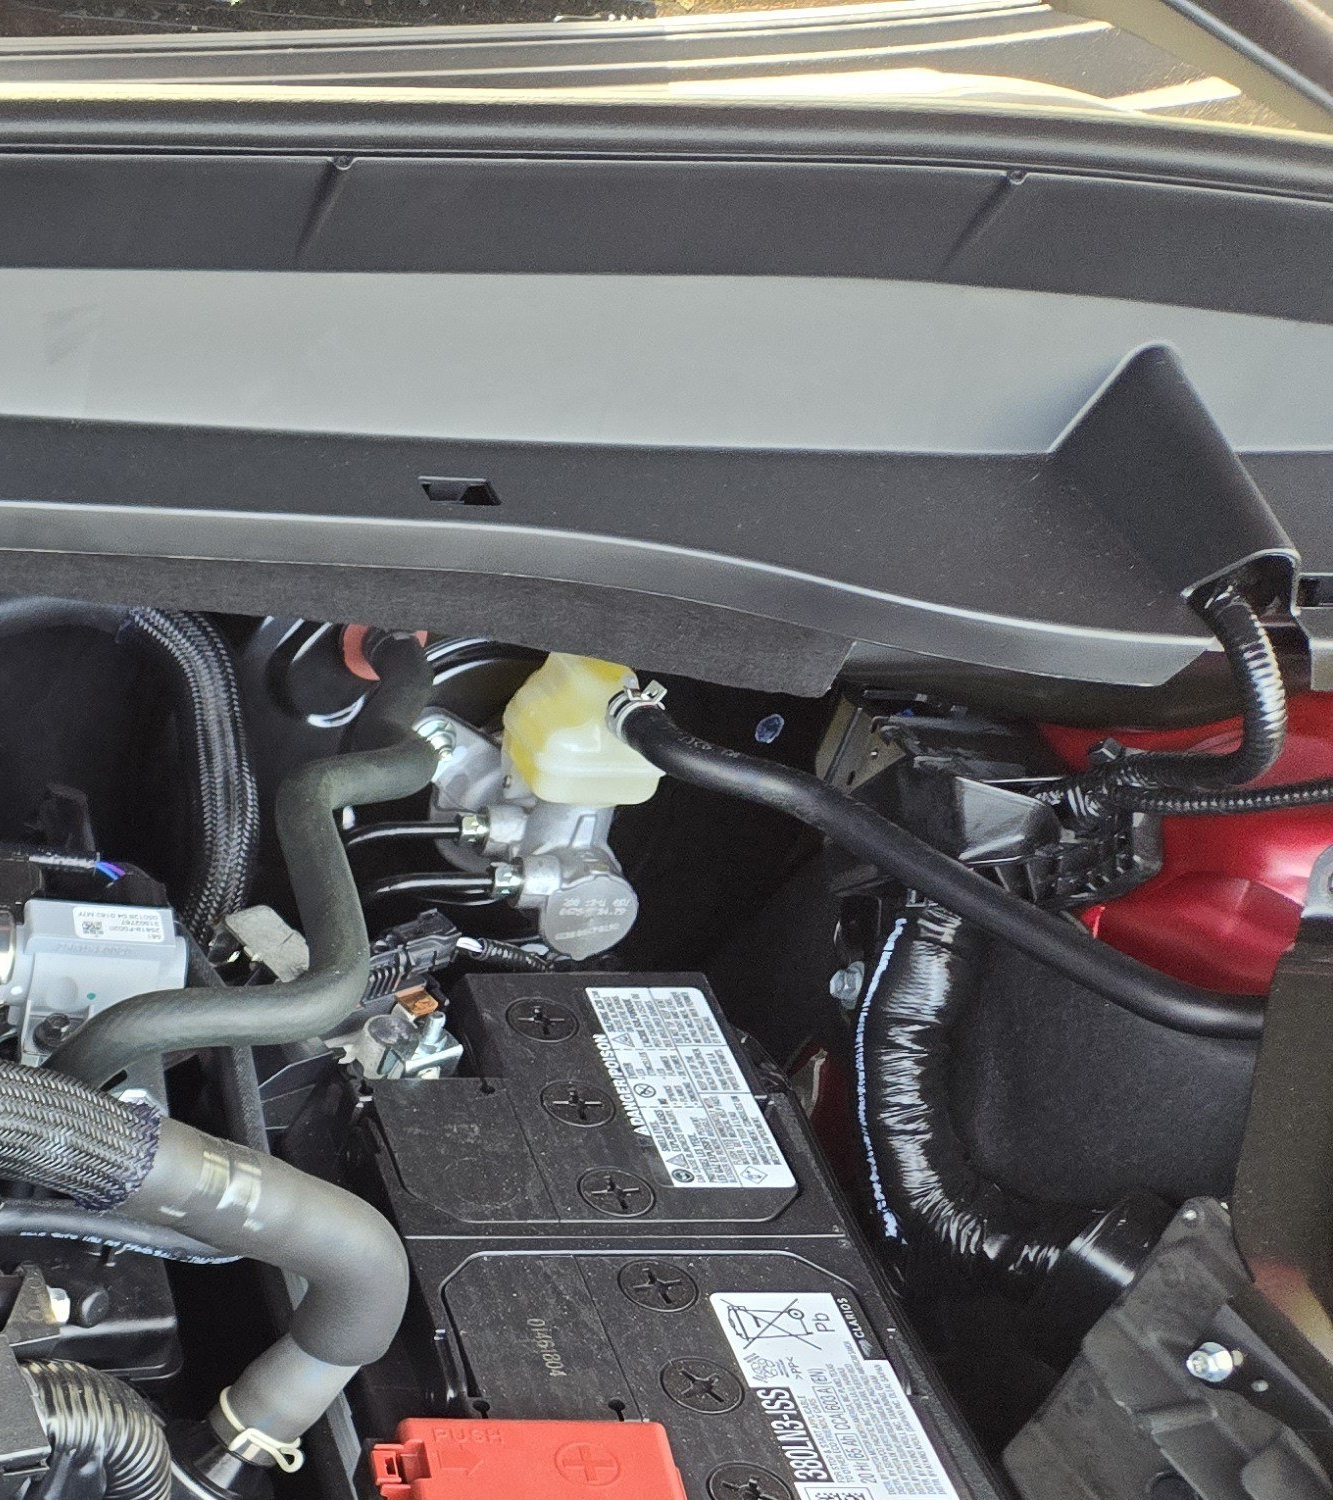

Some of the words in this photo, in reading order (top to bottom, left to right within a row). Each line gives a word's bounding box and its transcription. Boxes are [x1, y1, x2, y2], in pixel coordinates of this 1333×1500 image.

[591, 1033, 645, 1125] DANGER/POISON
[807, 1311, 836, 1332] Pb
[835, 1297, 867, 1338] CLARIOS
[817, 1394, 842, 1411] 603
[826, 1413, 852, 1430] CCA
[754, 1388, 829, 1480] 380LN3-ISS
[836, 1434, 859, 1446] Ah
[843, 1447, 866, 1459] 65
